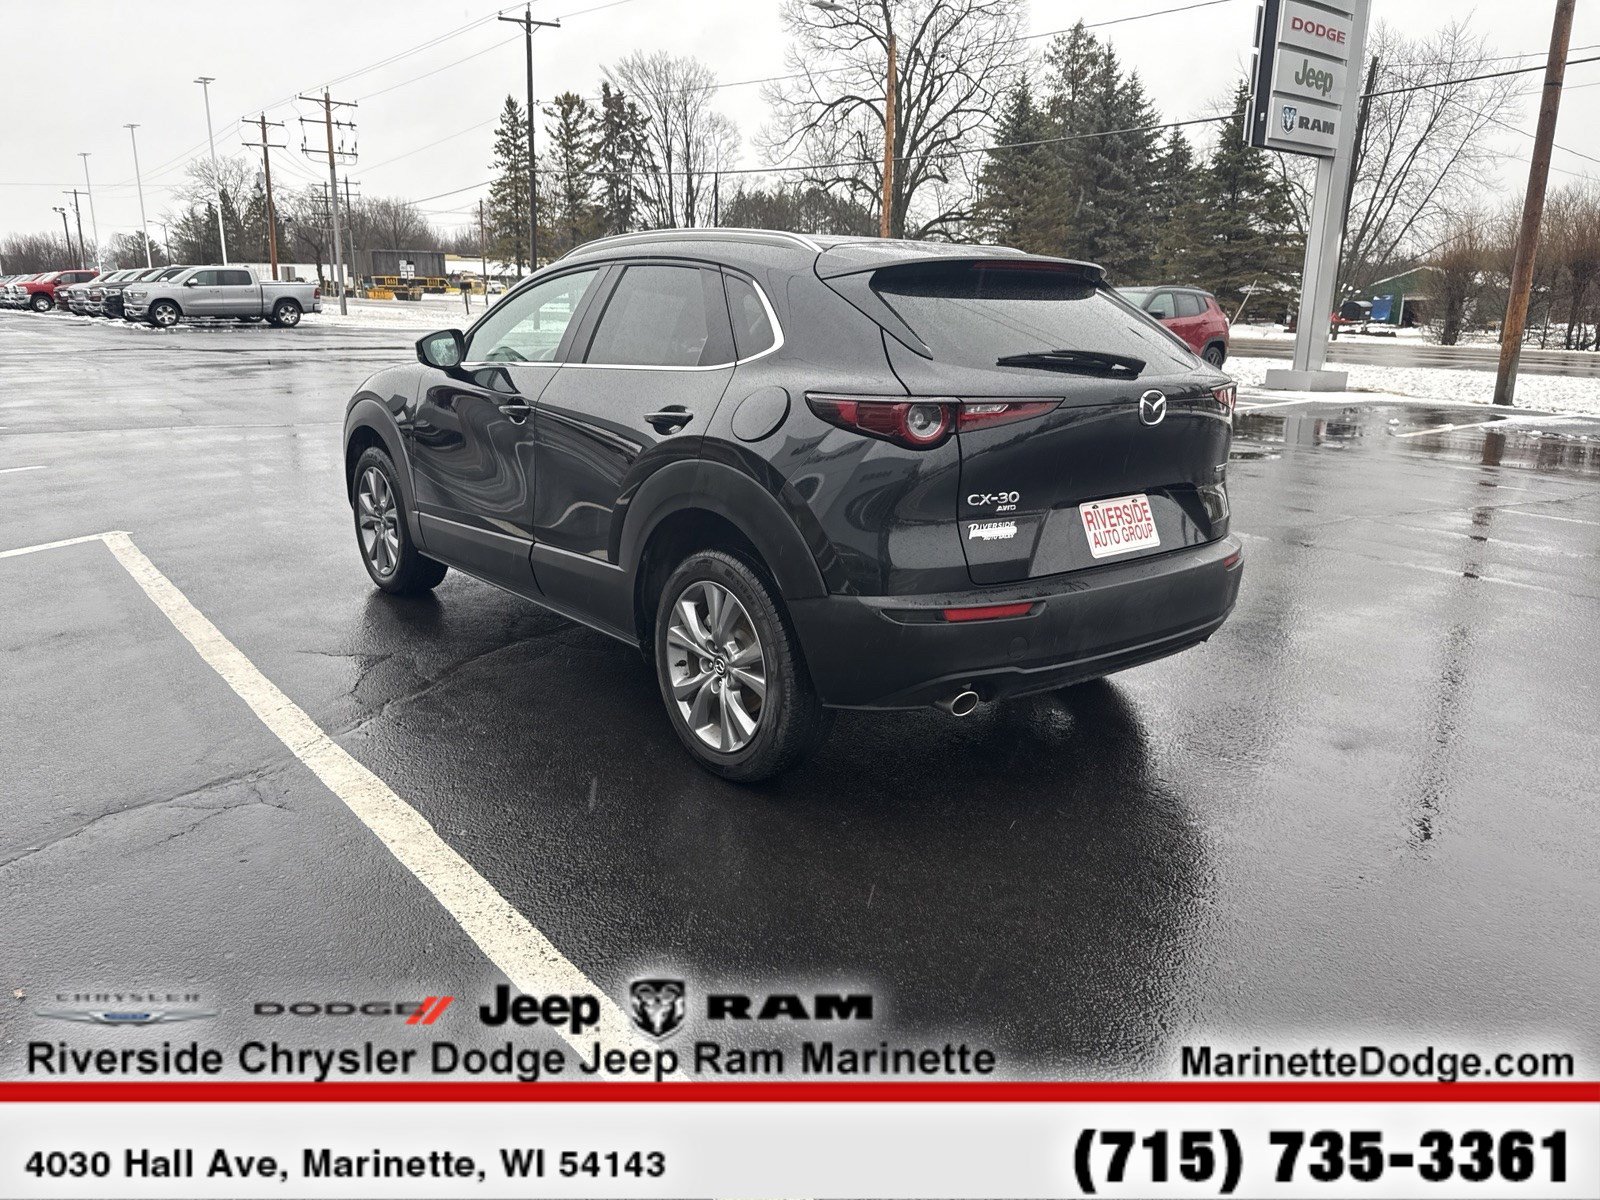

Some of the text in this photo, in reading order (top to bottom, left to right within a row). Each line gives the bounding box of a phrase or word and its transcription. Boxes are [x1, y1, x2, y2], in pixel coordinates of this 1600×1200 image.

[1291, 17, 1346, 44] DODGE
[1294, 59, 1334, 97] Jeep
[1298, 115, 1335, 135] RAM
[967, 491, 1020, 506] CX-30
[996, 504, 1017, 512] AWD
[1084, 502, 1151, 531] RIVERSIDE
[1093, 523, 1153, 548] AUTO GROUP
